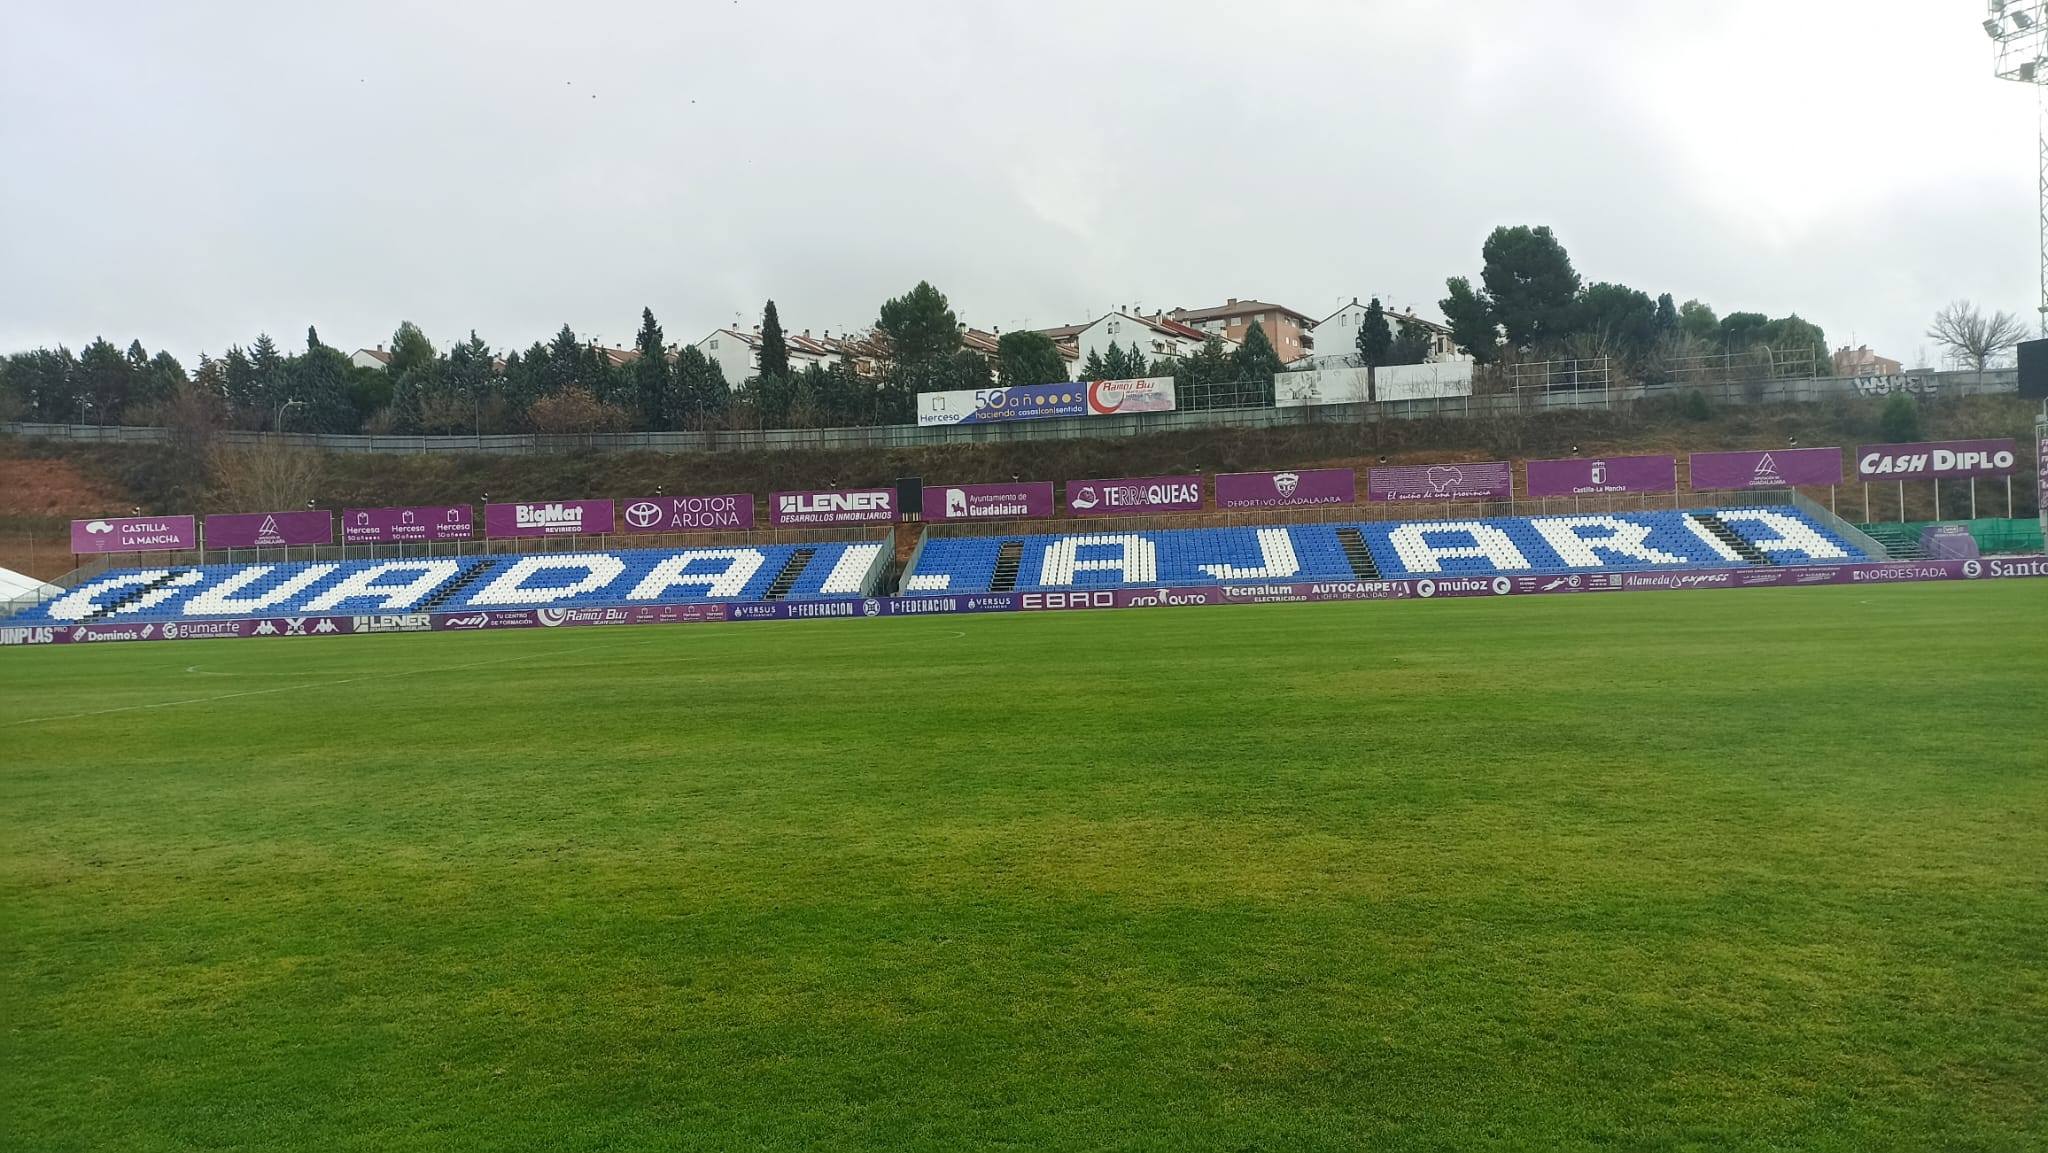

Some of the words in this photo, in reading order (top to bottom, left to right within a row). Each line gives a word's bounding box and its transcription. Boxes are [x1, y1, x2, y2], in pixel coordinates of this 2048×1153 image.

[975, 390, 1006, 409] 50
[920, 414, 960, 422] Hercesa
[975, 408, 1016, 420] haciendo
[969, 493, 1015, 503] Ayuntamiento
[1017, 492, 1027, 501] de
[1103, 483, 1199, 507] TERRAQUEAS
[1387, 491, 1396, 500] El
[1453, 490, 1491, 502] provincia
[673, 497, 736, 513] MOTOR
[796, 492, 891, 513] LENER
[1227, 499, 1276, 508] DEPORTIVO
[1278, 496, 1342, 505] GUADALAJARA
[516, 503, 583, 527] BigMat
[969, 502, 1028, 516] Guadalajara
[671, 511, 740, 528] ARJONA
[780, 513, 834, 523] DESARROLLOS
[836, 511, 892, 521] INMOBILIARIOS
[122, 523, 170, 533] CASTILLA-
[437, 522, 471, 531] Hercesa
[122, 536, 135, 545] LA
[137, 535, 180, 545] MANCHA
[1439, 578, 1487, 592] muñoz
[1625, 575, 1670, 586] Alameda
[1682, 572, 1730, 586] express
[1222, 584, 1292, 597] Tecnalum
[1312, 582, 1390, 594] AUTOCARPE
[976, 598, 1011, 606] VERSUS
[1022, 591, 1114, 609] EBRO
[566, 609, 601, 622] Ramos
[606, 608, 628, 620] Bus
[743, 605, 776, 614] VERSUS
[370, 614, 431, 627] LENER
[88, 629, 138, 641] Domino's
[180, 621, 240, 637] gumarfe
